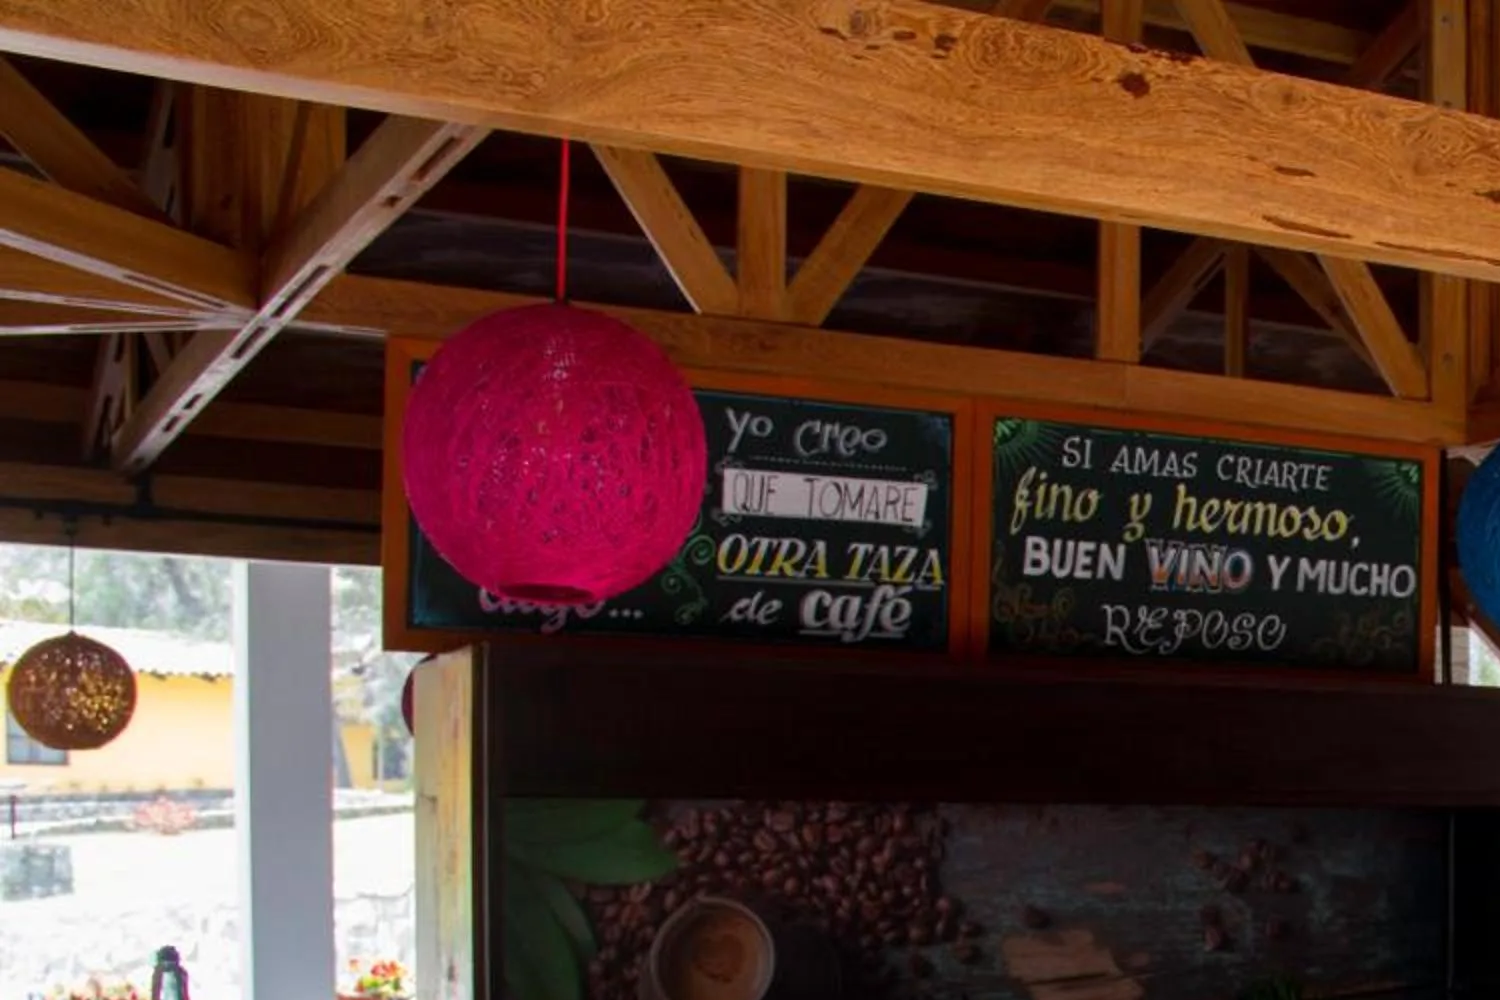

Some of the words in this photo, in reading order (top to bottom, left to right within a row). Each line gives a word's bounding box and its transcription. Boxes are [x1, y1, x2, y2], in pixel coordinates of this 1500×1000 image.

[1062, 436, 1092, 468] SI
[1110, 446, 1198, 479] AMAS
[1217, 454, 1331, 492] CRIARTE
[733, 472, 778, 515] QUE
[804, 478, 918, 523] TOMARE
[1010, 466, 1102, 536] fino
[1123, 491, 1153, 543] y
[717, 533, 830, 578] OTRA
[843, 541, 945, 586] TAZA
[1023, 535, 1127, 581] BUEN
[1144, 537, 1252, 594] VINO
[1267, 555, 1293, 591] Y
[1296, 557, 1417, 598] MUCHO
[719, 588, 784, 625] de
[799, 583, 913, 643] café
